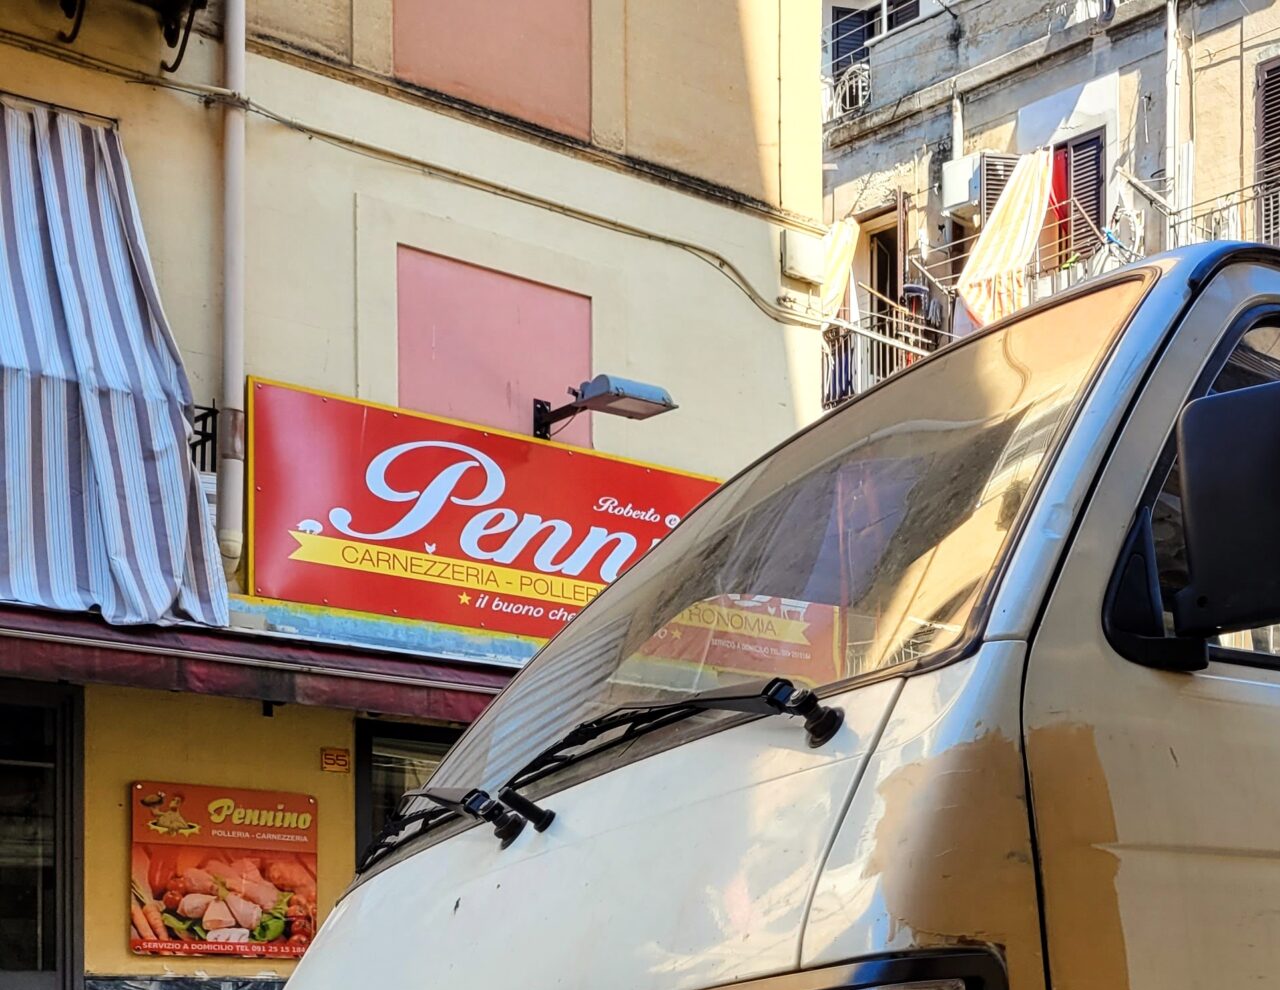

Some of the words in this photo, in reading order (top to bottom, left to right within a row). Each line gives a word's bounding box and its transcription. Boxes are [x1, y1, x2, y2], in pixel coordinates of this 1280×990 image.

[329, 440, 661, 583] Penn
[593, 496, 661, 523] Roberto
[341, 545, 500, 588] CARNEZZERIA
[520, 575, 604, 603] POLLER
[475, 593, 489, 609] il
[491, 597, 544, 618] buono
[548, 607, 577, 622] che
[323, 753, 348, 768] 55
[208, 798, 312, 829] Pennino
[211, 829, 250, 838] POLLERIA
[256, 833, 309, 842] CARNEZZERIA
[142, 942, 182, 950] SERVIZIO
[191, 943, 234, 951] DOMICILIO
